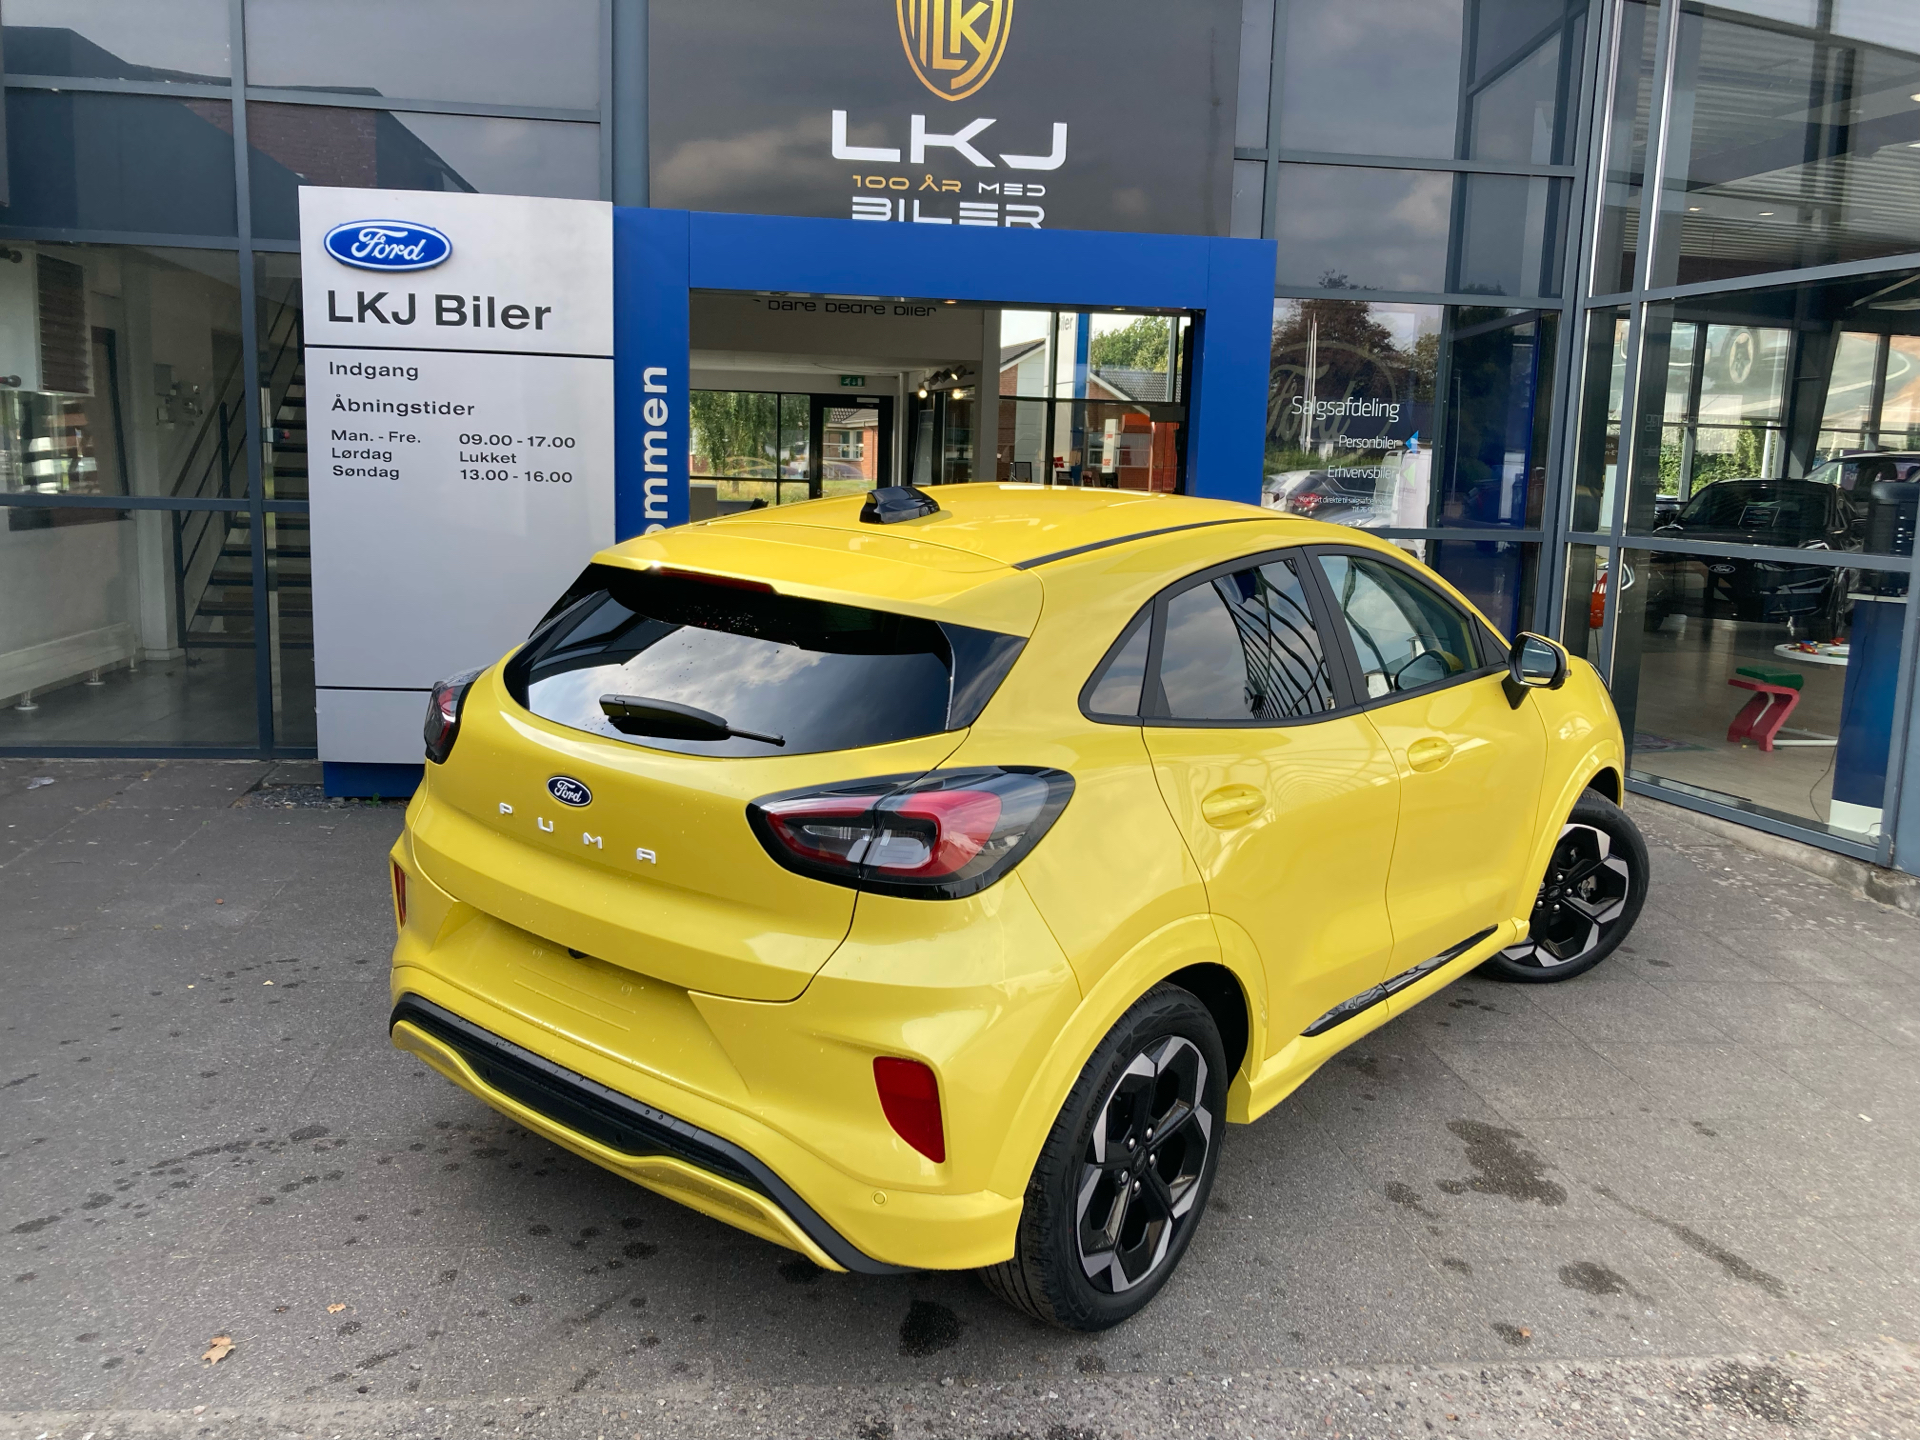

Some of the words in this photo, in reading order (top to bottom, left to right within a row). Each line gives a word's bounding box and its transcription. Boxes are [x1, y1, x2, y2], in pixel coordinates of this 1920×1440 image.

[832, 109, 1067, 170] LKJ
[852, 174, 910, 190] 100
[919, 174, 962, 192] ÅR
[979, 181, 1046, 197] MED
[852, 196, 1045, 229] BILER
[351, 228, 426, 260] Ford
[328, 289, 416, 325] LKJ
[435, 293, 551, 330] Biler
[329, 361, 419, 381] Indgang
[331, 394, 475, 417] Åbningstider
[1291, 395, 1400, 423] Salgsafdeling
[331, 429, 374, 442] Man.
[388, 431, 421, 443] Fre.
[458, 433, 512, 447] 09.00
[527, 436, 576, 449] 17.00
[1339, 434, 1398, 450] Personbiler
[331, 447, 392, 462] Lørdag
[459, 451, 517, 464] Lukket
[332, 465, 400, 481] Søndag
[459, 468, 509, 481] 13.00
[524, 471, 573, 484] 16.00
[1327, 465, 1396, 480] Erhvervsbiler
[554, 780, 583, 803] Ford
[499, 802, 656, 864] PUMA
[1076, 1071, 1114, 1145] EcoContact
